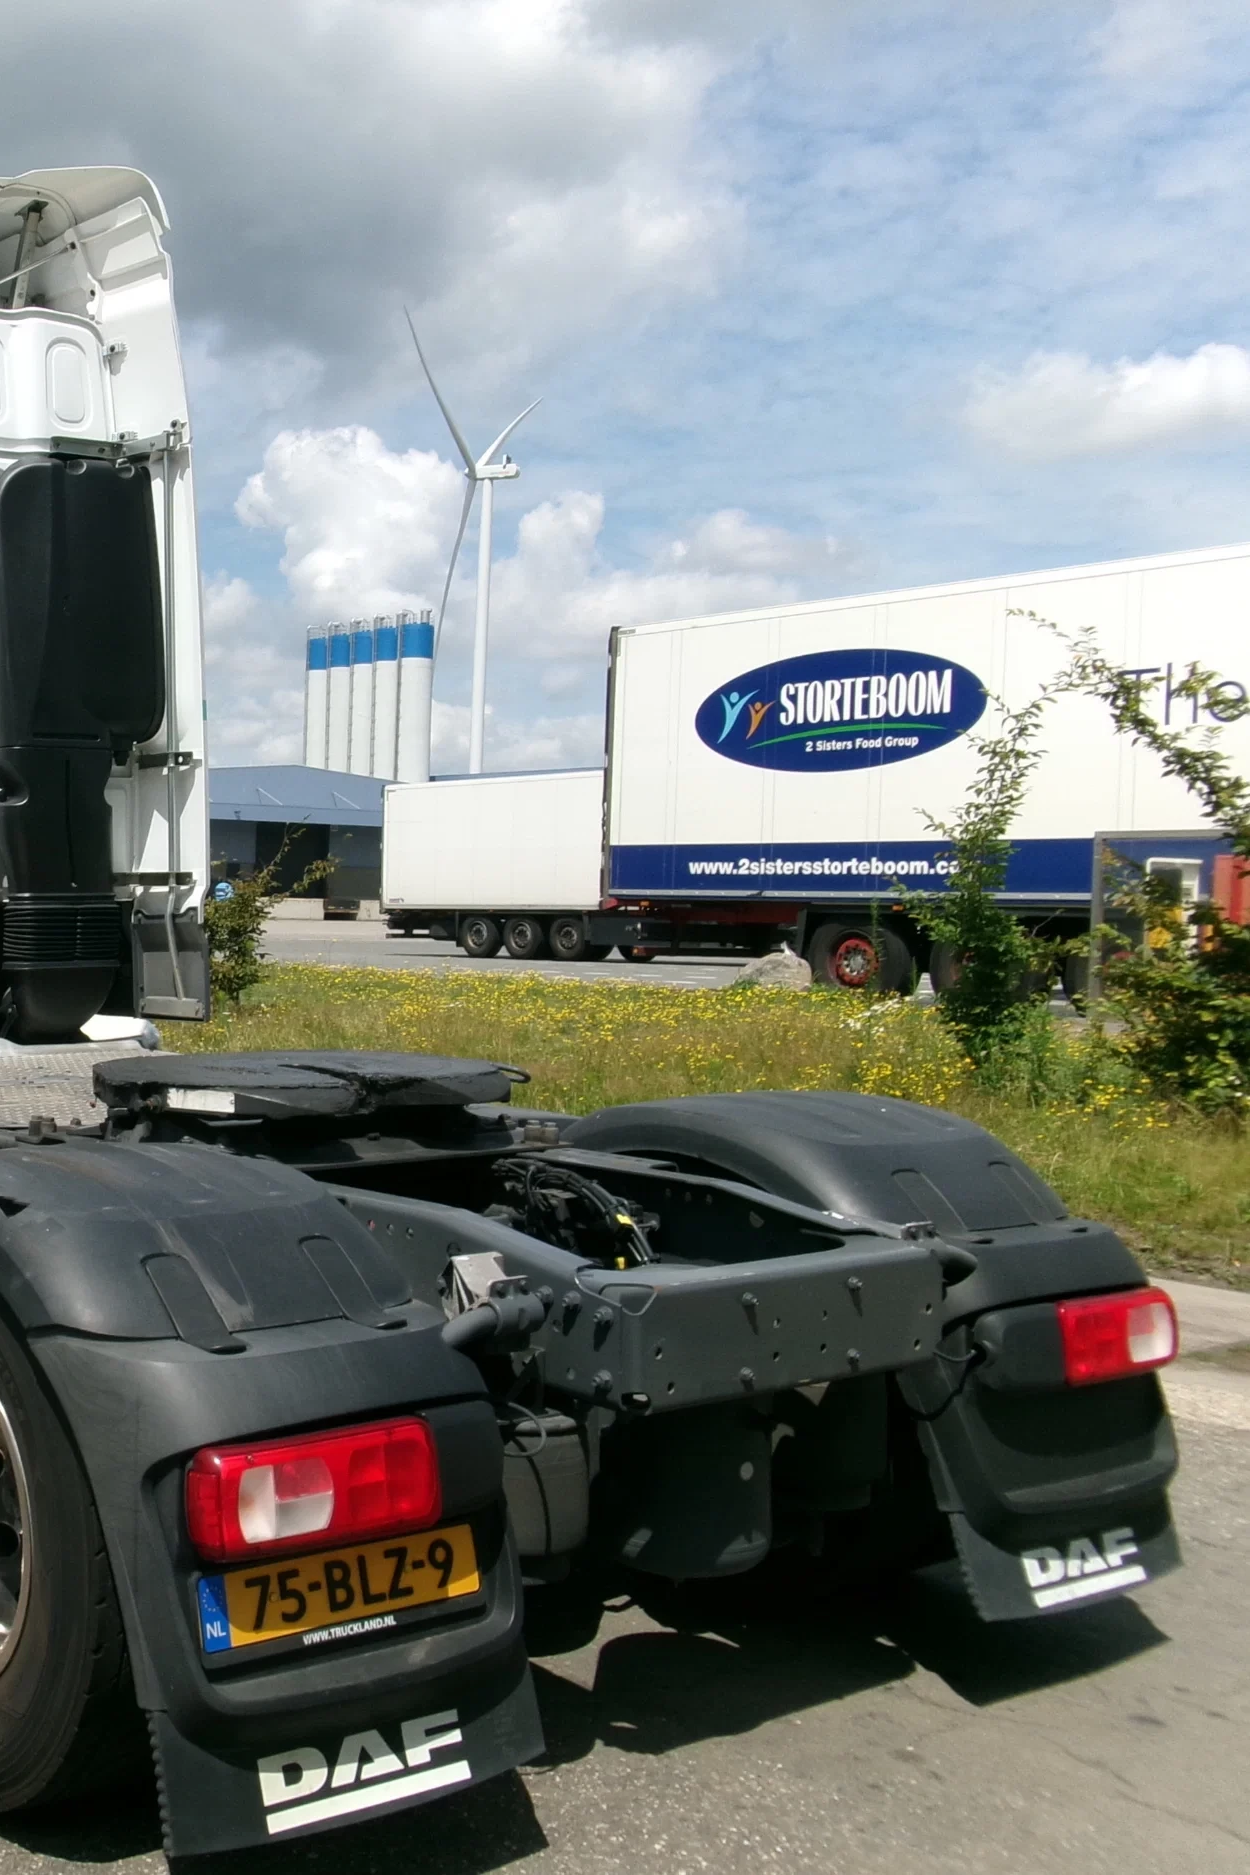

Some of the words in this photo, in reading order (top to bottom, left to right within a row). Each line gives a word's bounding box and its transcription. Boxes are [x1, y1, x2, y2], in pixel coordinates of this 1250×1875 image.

[779, 668, 953, 726] STORTEBOOM
[1117, 662, 1248, 726] The
[805, 741, 814, 752] 2
[815, 740, 853, 752] Sisters
[855, 737, 883, 749] Food
[884, 736, 919, 748] Group
[245, 1539, 454, 1632] 75-BLZ-9
[1021, 1527, 1139, 1588] DAF
[206, 1621, 227, 1640] NL
[302, 1615, 397, 1646] WWW.TRUCKLAND.NL
[257, 1709, 463, 1807] DAF
